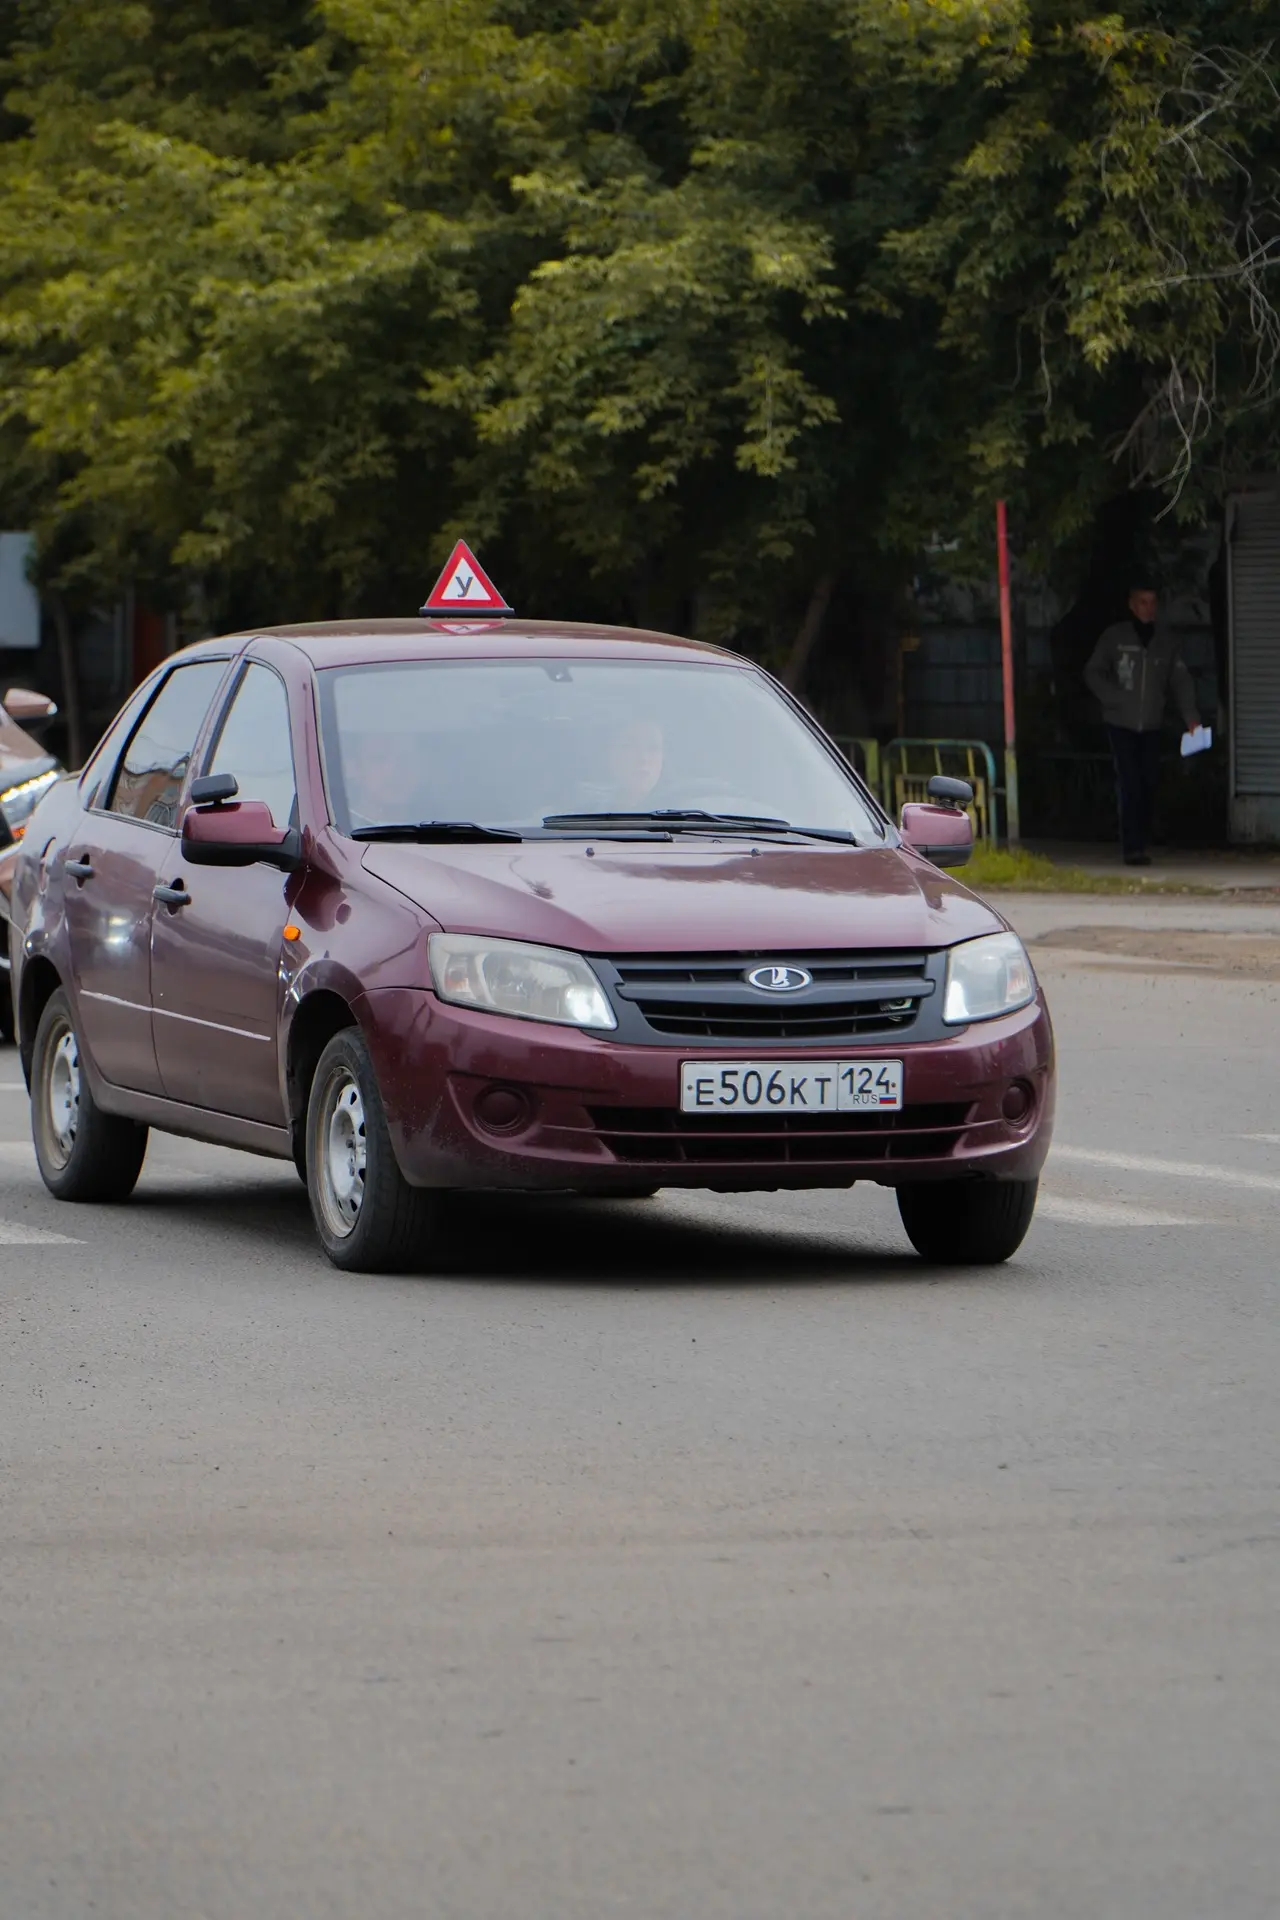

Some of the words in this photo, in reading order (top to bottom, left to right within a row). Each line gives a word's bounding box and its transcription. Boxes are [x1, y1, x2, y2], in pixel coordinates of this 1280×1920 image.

[455, 576, 473, 598] У
[695, 1070, 832, 1106] Е506КТ
[840, 1067, 890, 1095] 124
[852, 1094, 878, 1105] RUS
